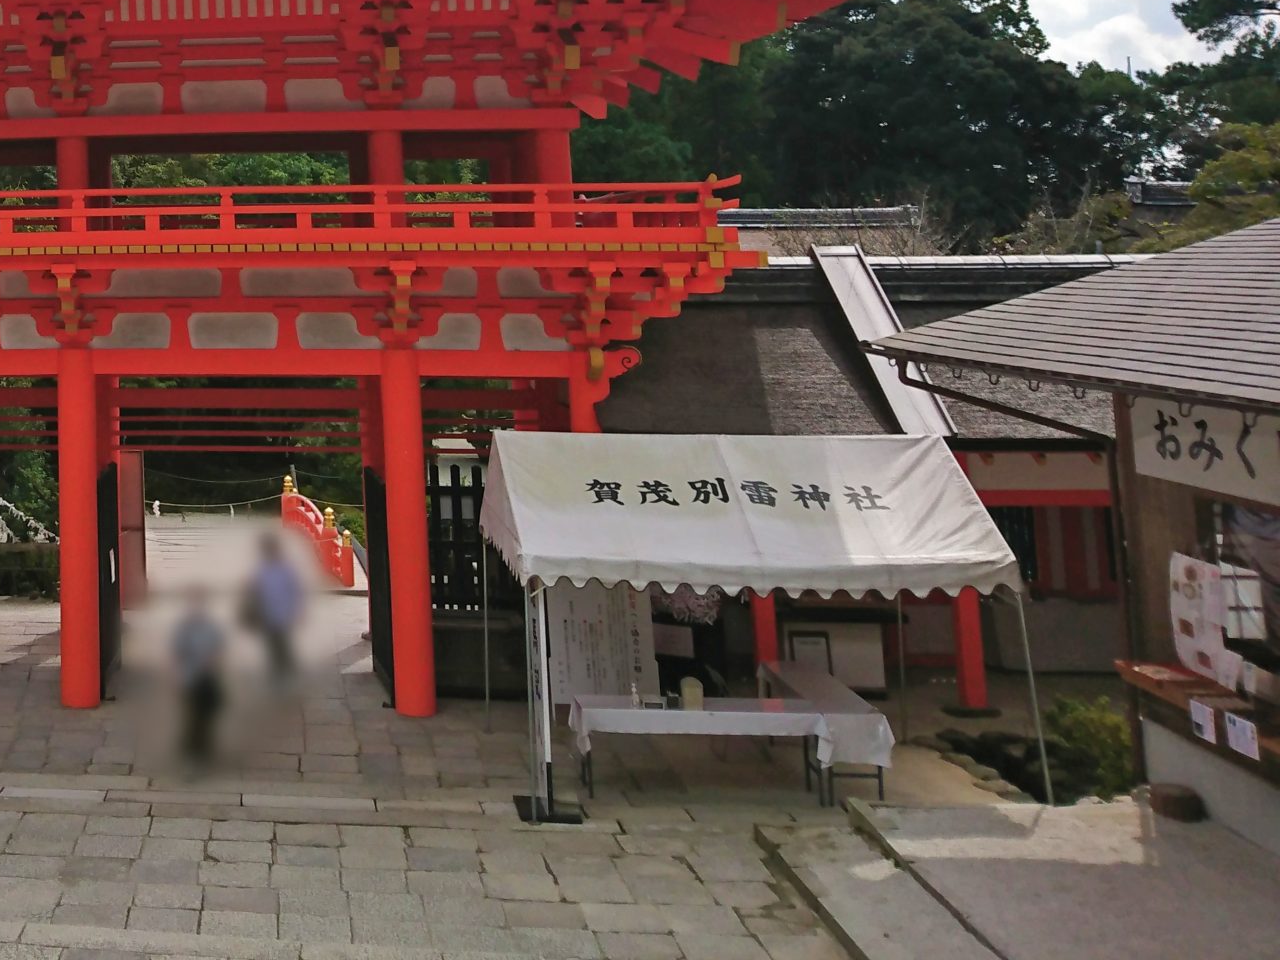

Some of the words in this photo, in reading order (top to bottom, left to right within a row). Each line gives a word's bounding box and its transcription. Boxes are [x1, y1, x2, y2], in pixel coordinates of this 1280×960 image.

[1154, 409, 1280, 479] おみく
[585, 477, 891, 511] 賀茂別雷神社
